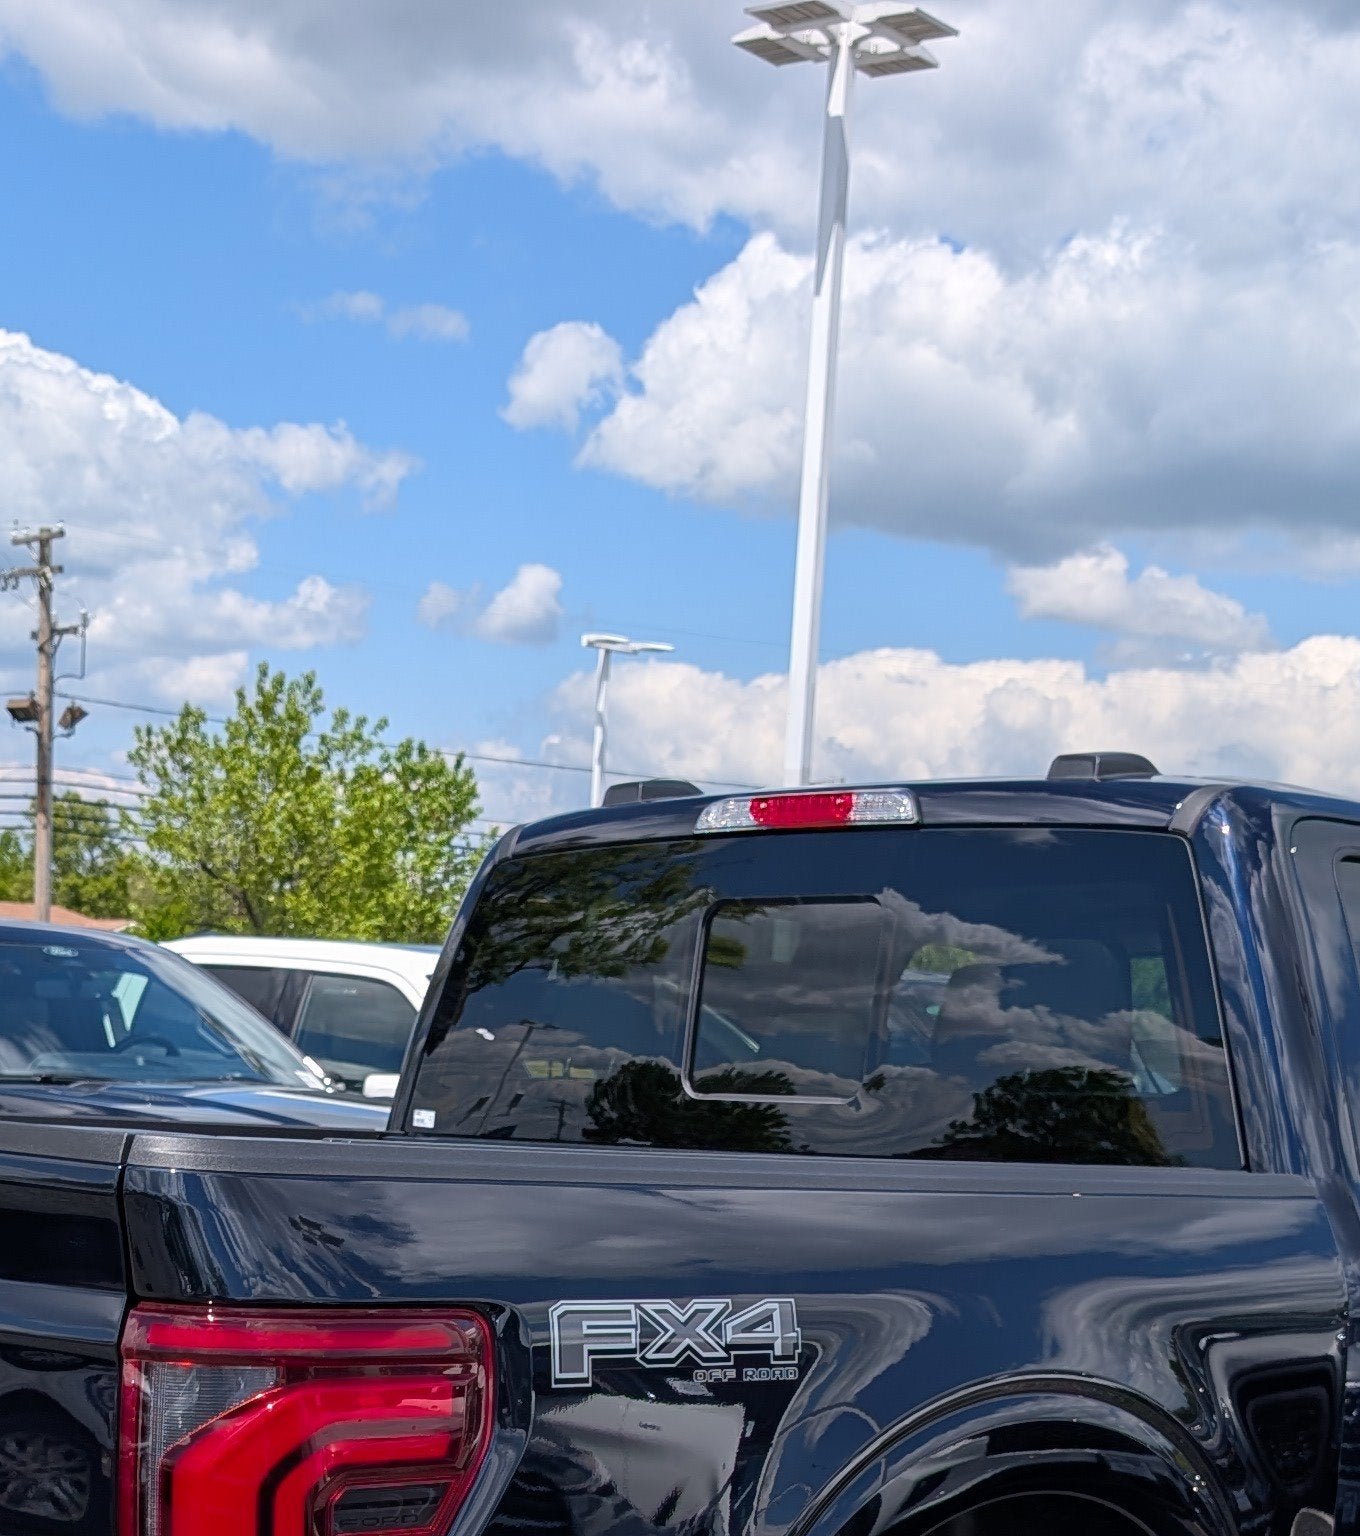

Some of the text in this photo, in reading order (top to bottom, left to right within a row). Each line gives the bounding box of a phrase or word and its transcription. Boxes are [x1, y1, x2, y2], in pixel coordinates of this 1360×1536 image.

[548, 1298, 802, 1388] FX4
[693, 1367, 799, 1383] OFF ROAD
[339, 1514, 418, 1526] FORD
